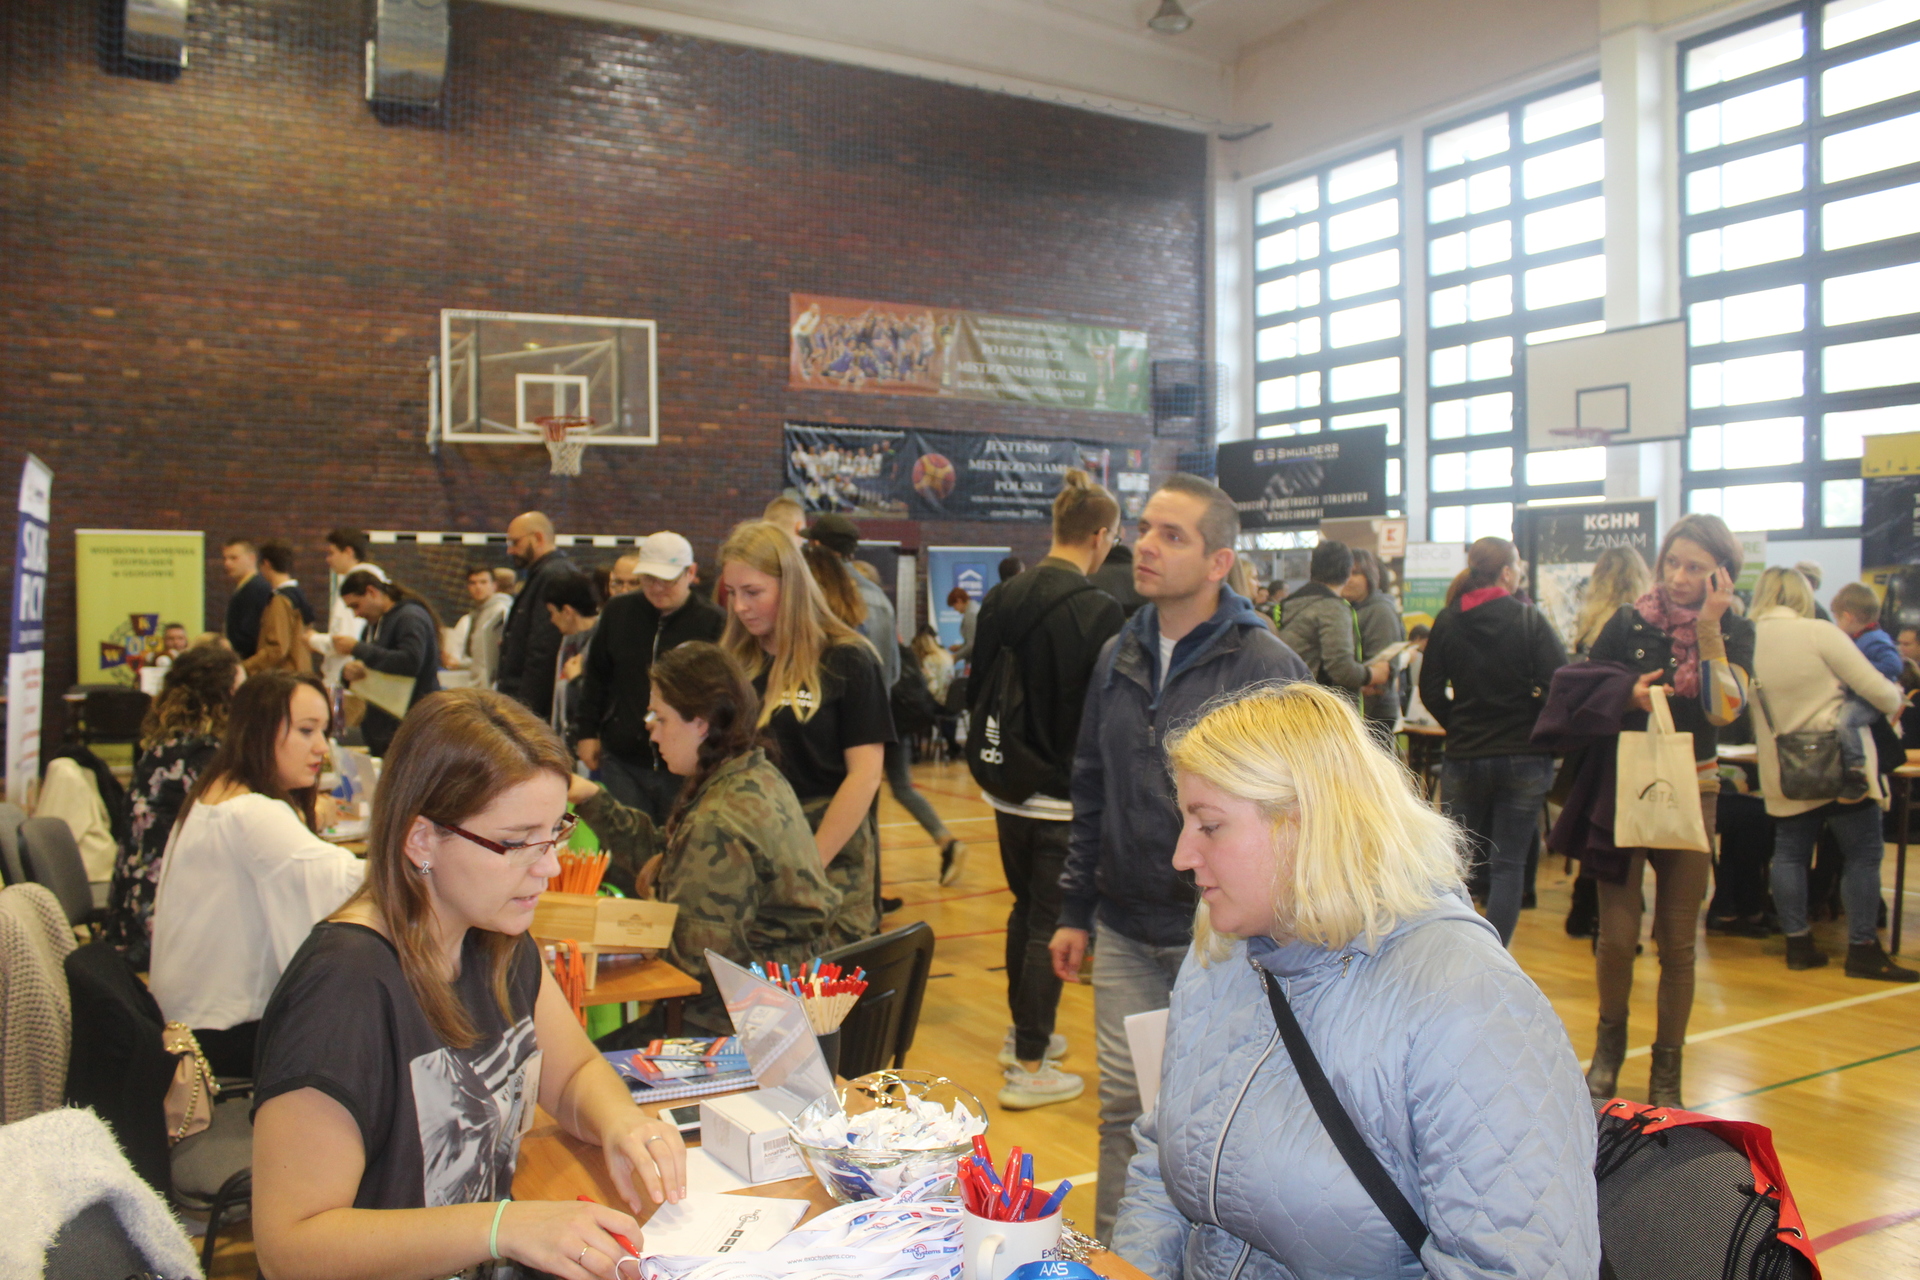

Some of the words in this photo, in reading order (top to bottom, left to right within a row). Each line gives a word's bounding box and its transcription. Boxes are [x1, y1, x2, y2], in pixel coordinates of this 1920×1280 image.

[1277, 443, 1340, 459] SMULDERS
[994, 480, 1043, 492] POLSKI
[1584, 512, 1640, 531] KGHM
[1584, 533, 1647, 550] ZANAM
[915, 1250, 941, 1258] Systems
[1039, 1262, 1069, 1276] AAS
